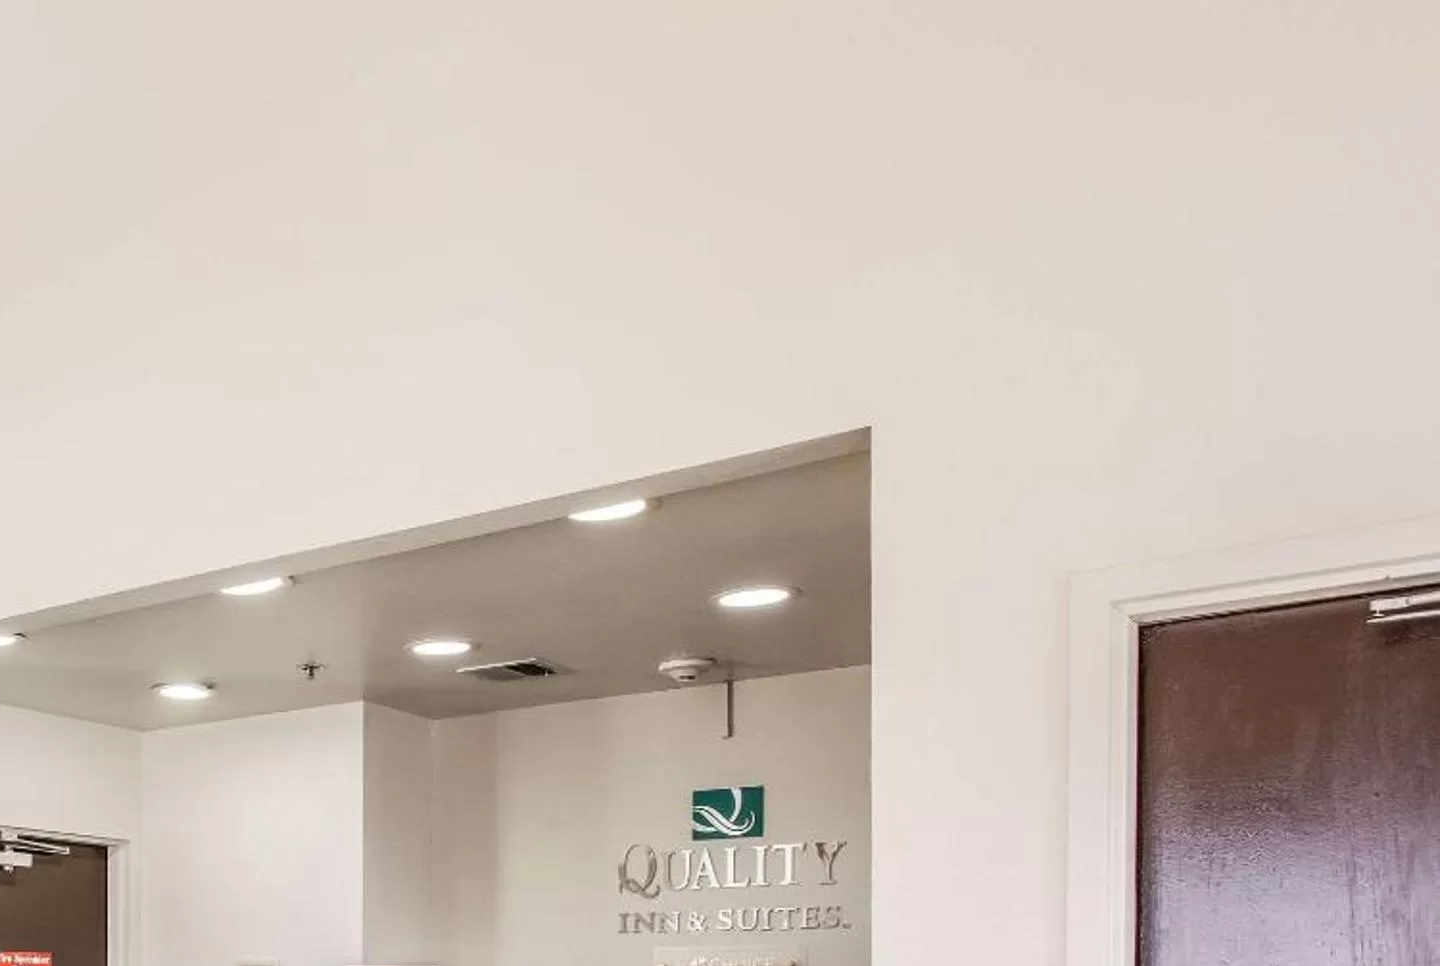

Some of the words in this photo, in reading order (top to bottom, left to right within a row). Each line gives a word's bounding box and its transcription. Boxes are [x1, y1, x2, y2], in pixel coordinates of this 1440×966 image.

[618, 841, 847, 898] QUALITY
[618, 911, 681, 934] INN
[687, 911, 709, 932] &
